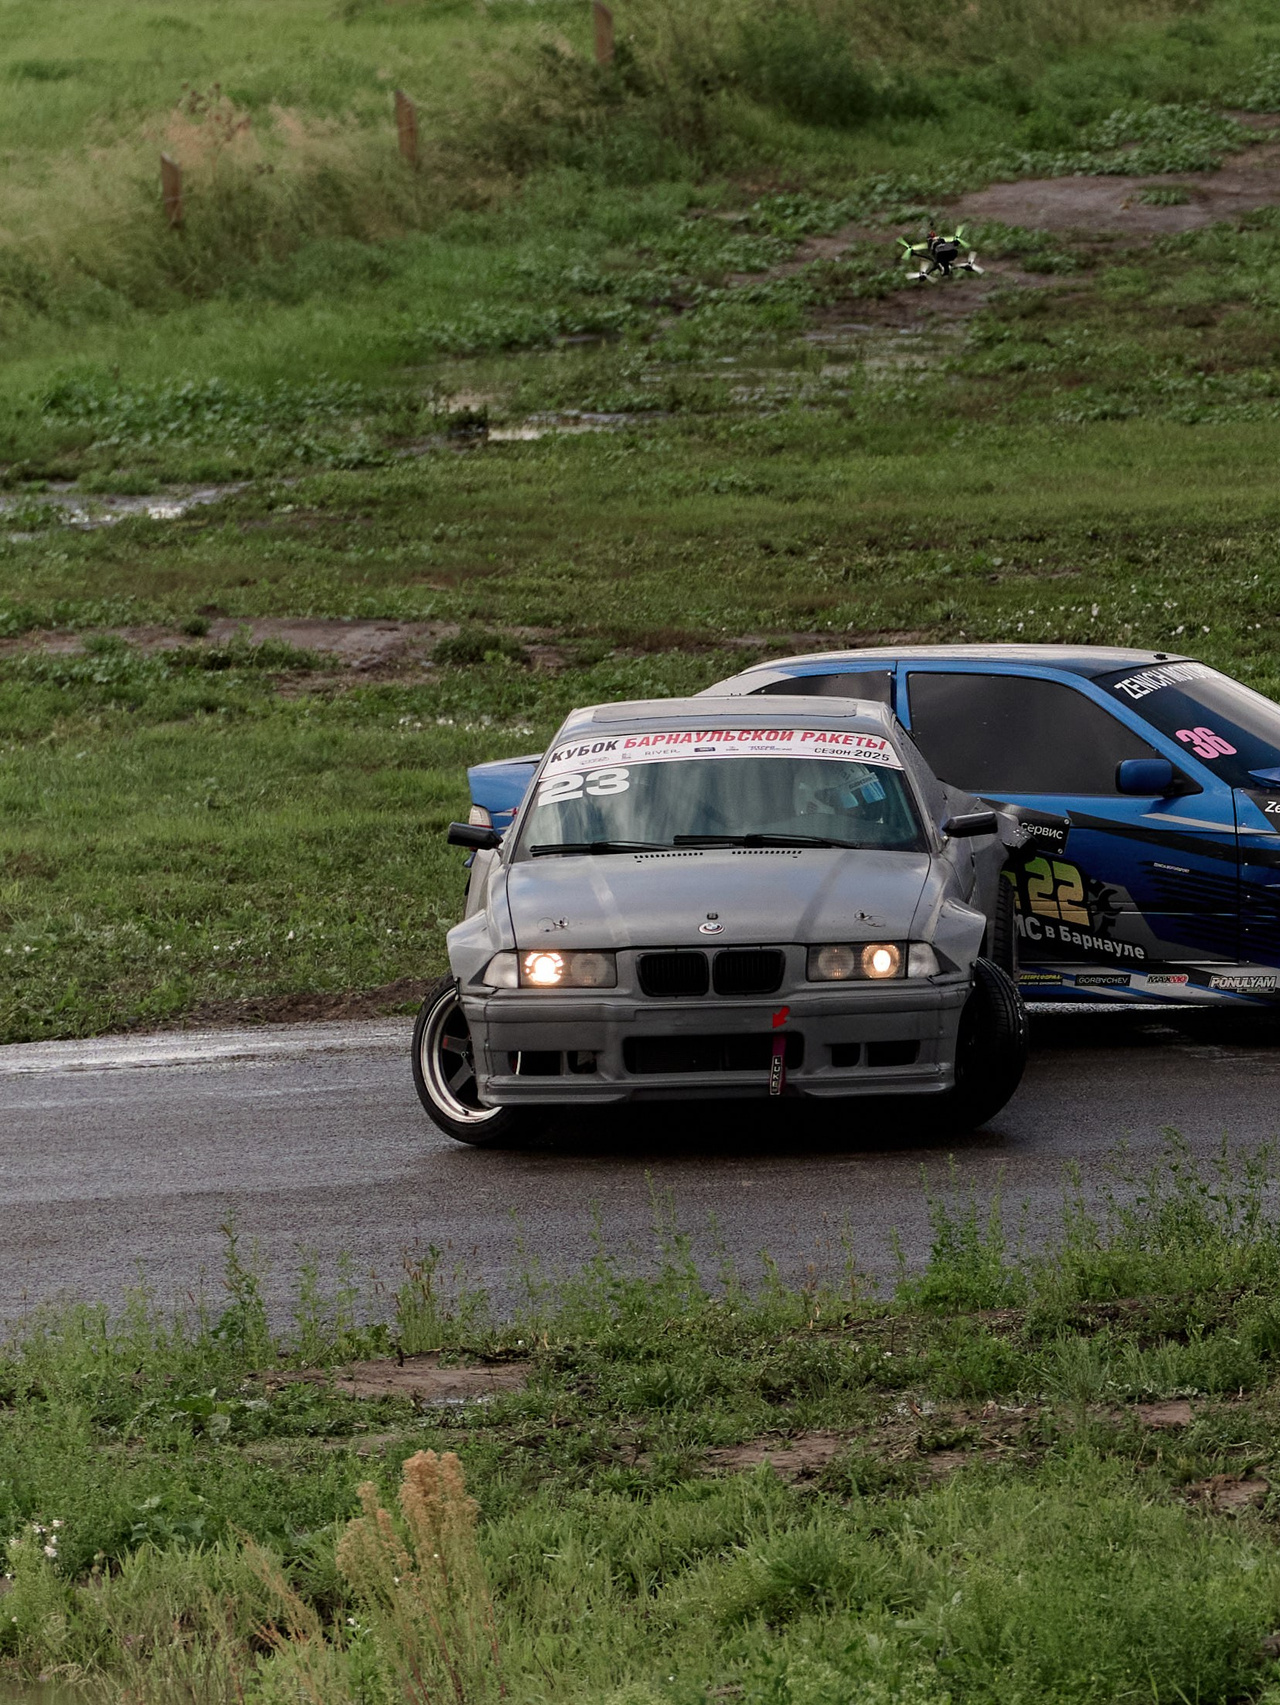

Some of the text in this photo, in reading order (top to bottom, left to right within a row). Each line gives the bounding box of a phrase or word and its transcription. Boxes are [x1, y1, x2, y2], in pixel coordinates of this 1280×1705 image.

[1113, 667, 1177, 700] ZENICH
[550, 739, 620, 763] КУБОК
[800, 731, 887, 750] РАКЕТЫ
[814, 747, 891, 762] СЕЗОН 2025
[1175, 727, 1237, 759] 36
[537, 767, 630, 807] 23
[1044, 925, 1055, 938] в
[1059, 925, 1145, 959] Барнауле
